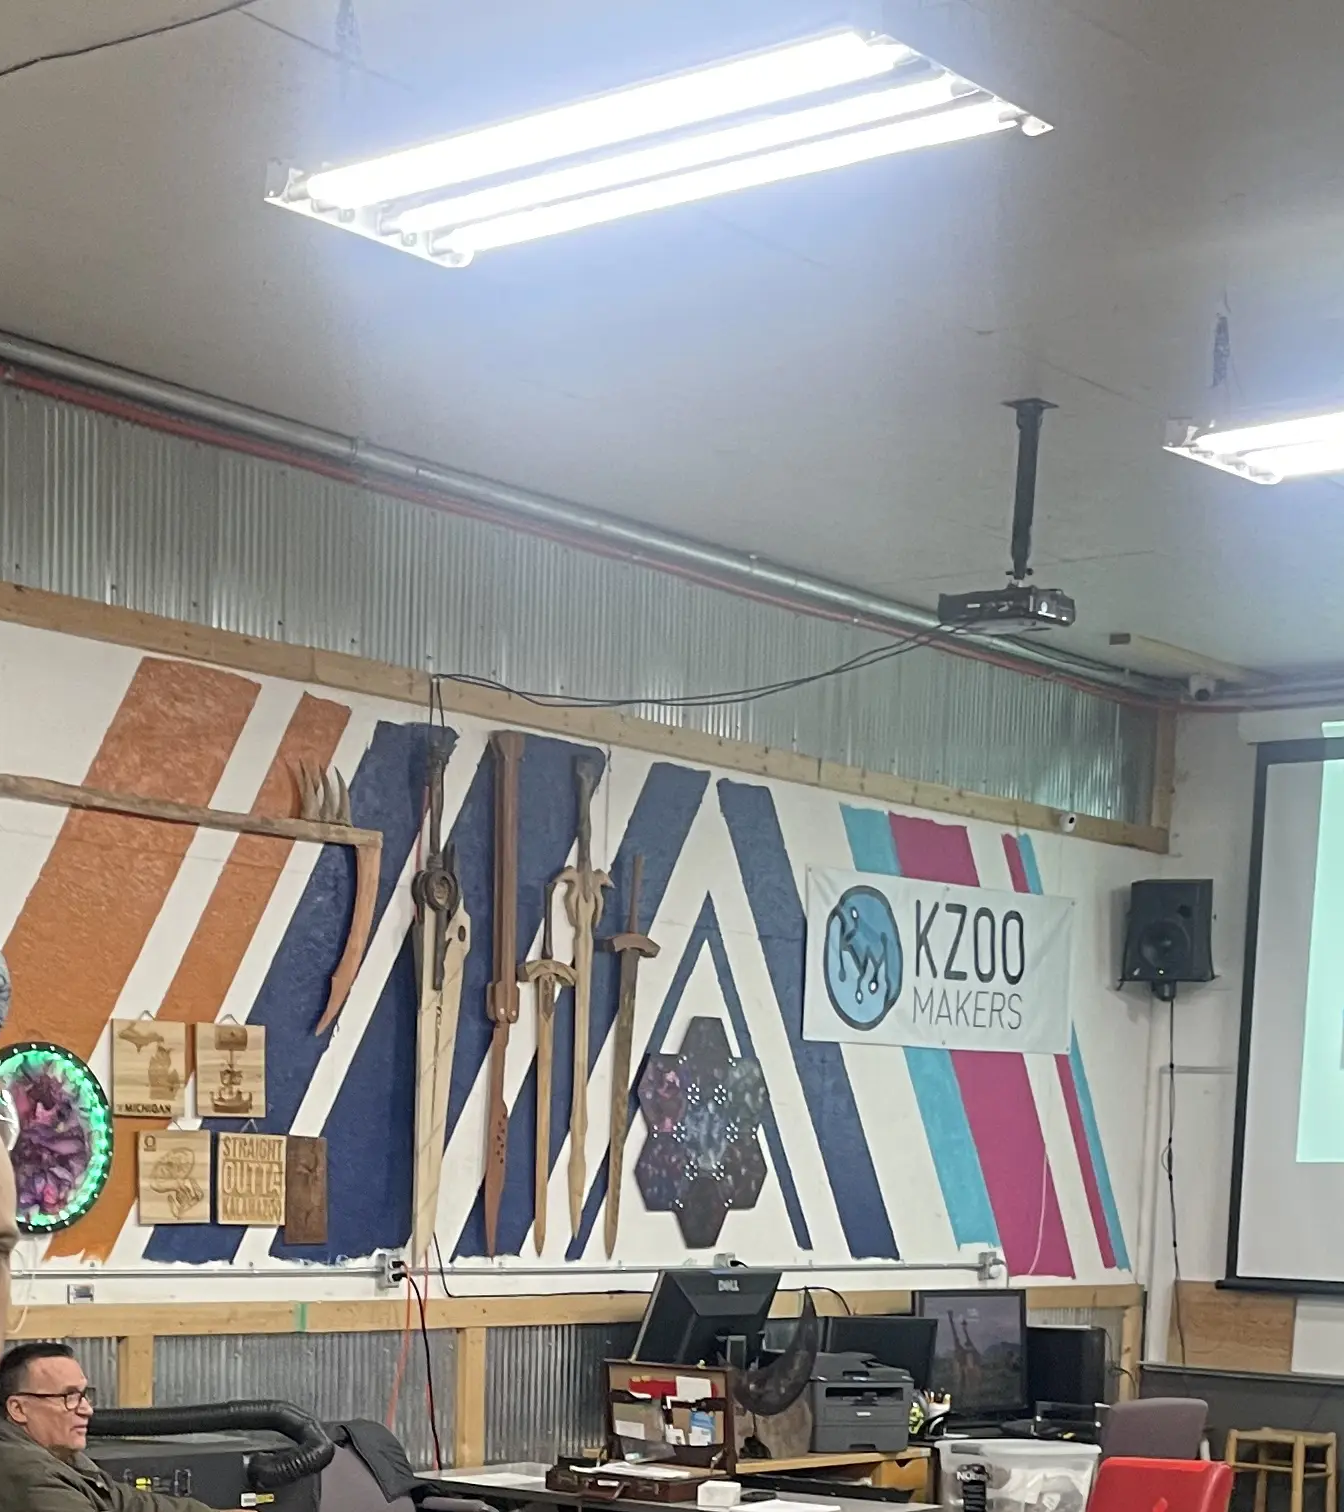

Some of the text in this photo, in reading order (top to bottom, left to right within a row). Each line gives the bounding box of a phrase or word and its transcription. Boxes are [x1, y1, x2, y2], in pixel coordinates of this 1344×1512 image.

[915, 898, 1026, 986] KZOO
[912, 985, 1024, 1031] MAKERS
[222, 1135, 284, 1160] STRAIGHT
[222, 1160, 284, 1197] OUTTA
